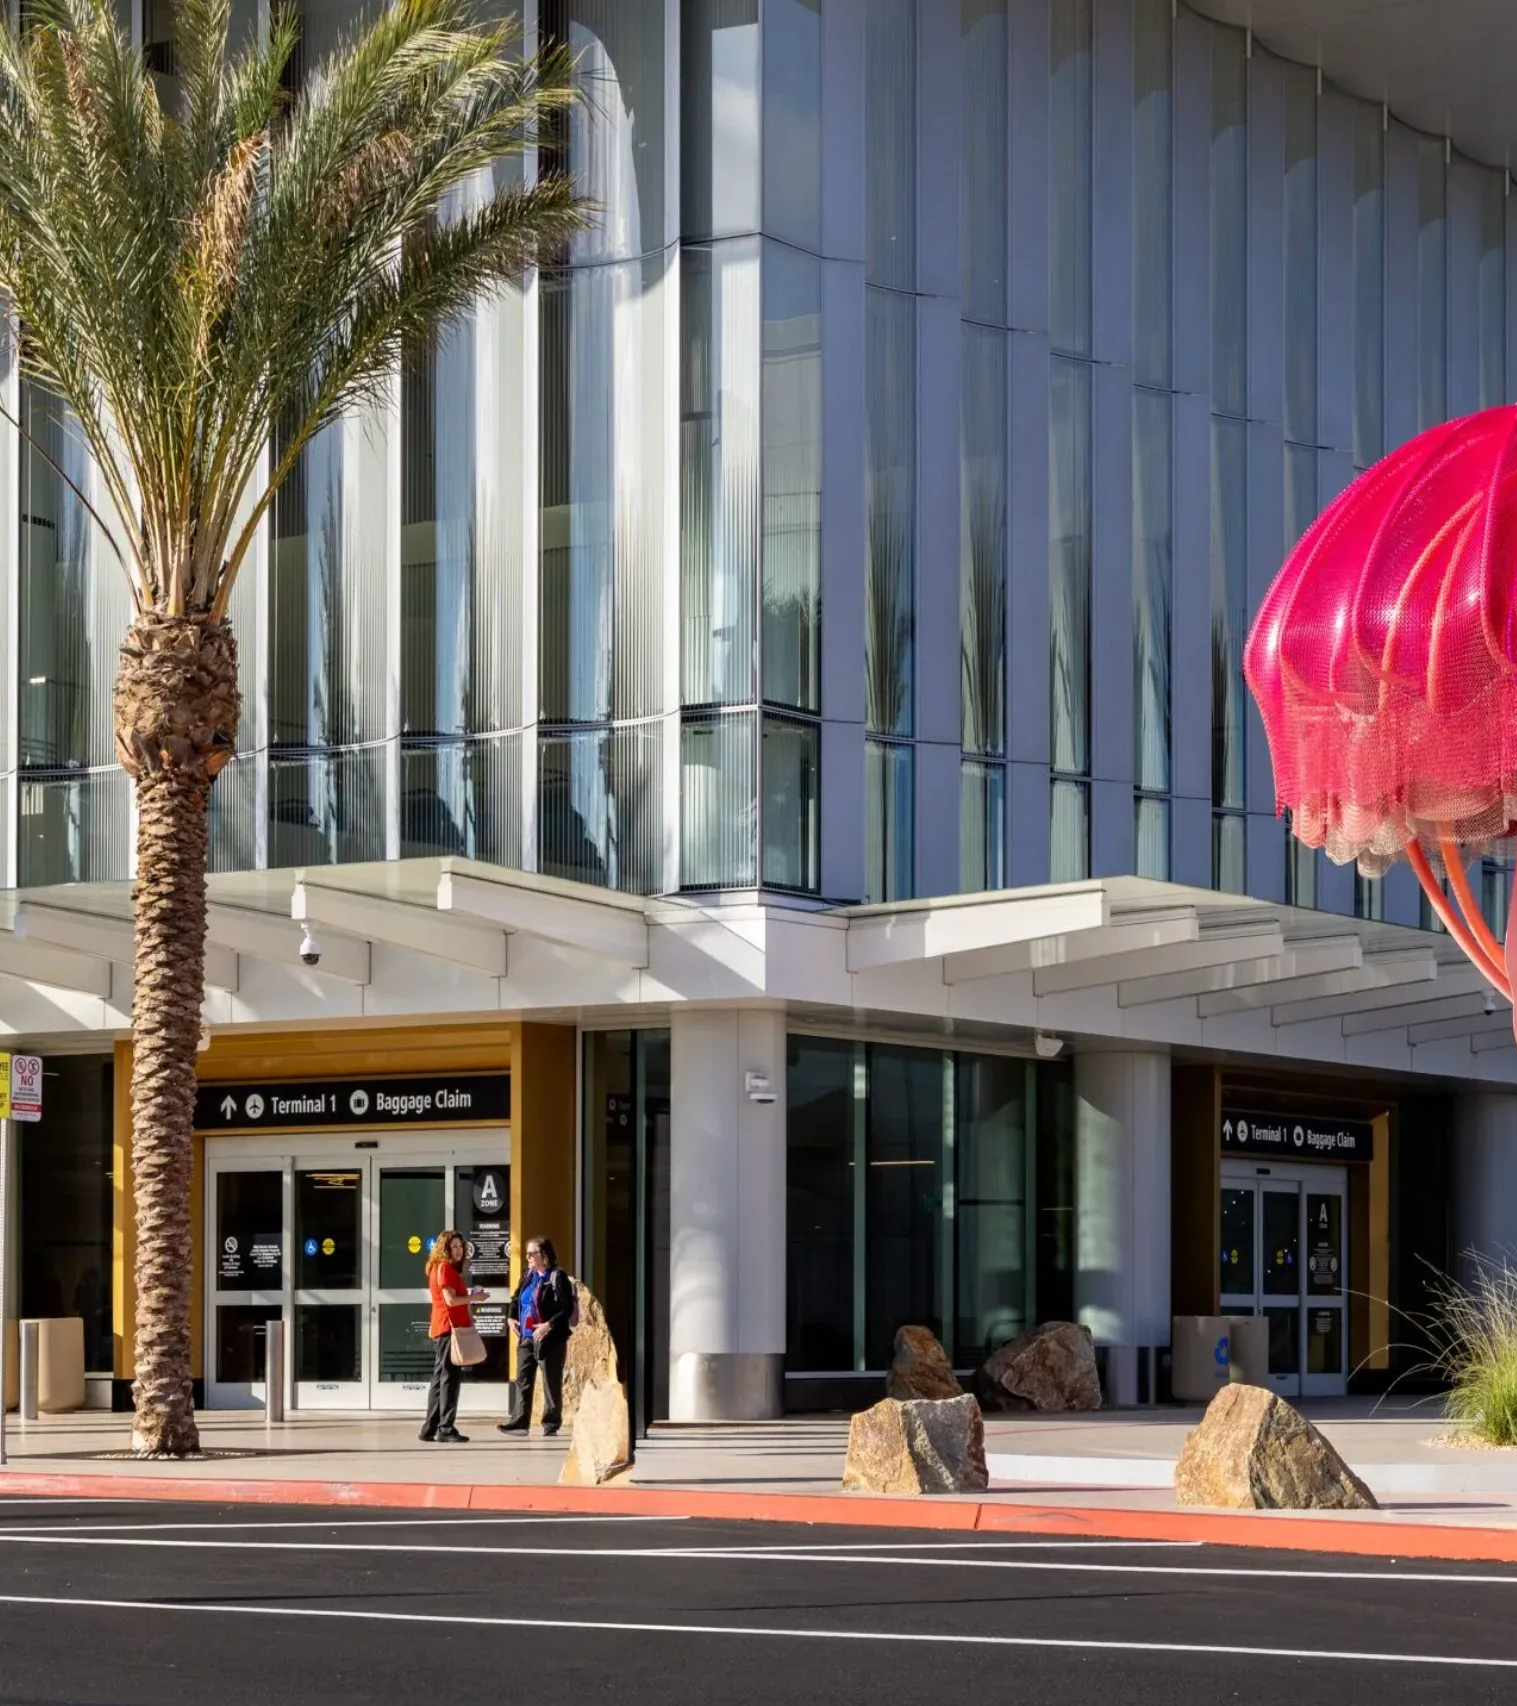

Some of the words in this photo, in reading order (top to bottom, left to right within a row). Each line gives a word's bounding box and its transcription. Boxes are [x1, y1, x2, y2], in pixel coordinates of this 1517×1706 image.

[21, 1074, 34, 1087] NO
[271, 1094, 326, 1114] Terminal
[330, 1094, 337, 1112] 1
[376, 1092, 432, 1115] Baggage
[435, 1089, 472, 1109] Claim
[1251, 1124, 1281, 1142] Terminal
[1283, 1127, 1287, 1142] 1
[1307, 1129, 1336, 1150] Baggage
[1337, 1132, 1356, 1148] Claim
[481, 1174, 498, 1199] A
[1319, 1203, 1328, 1222] A
